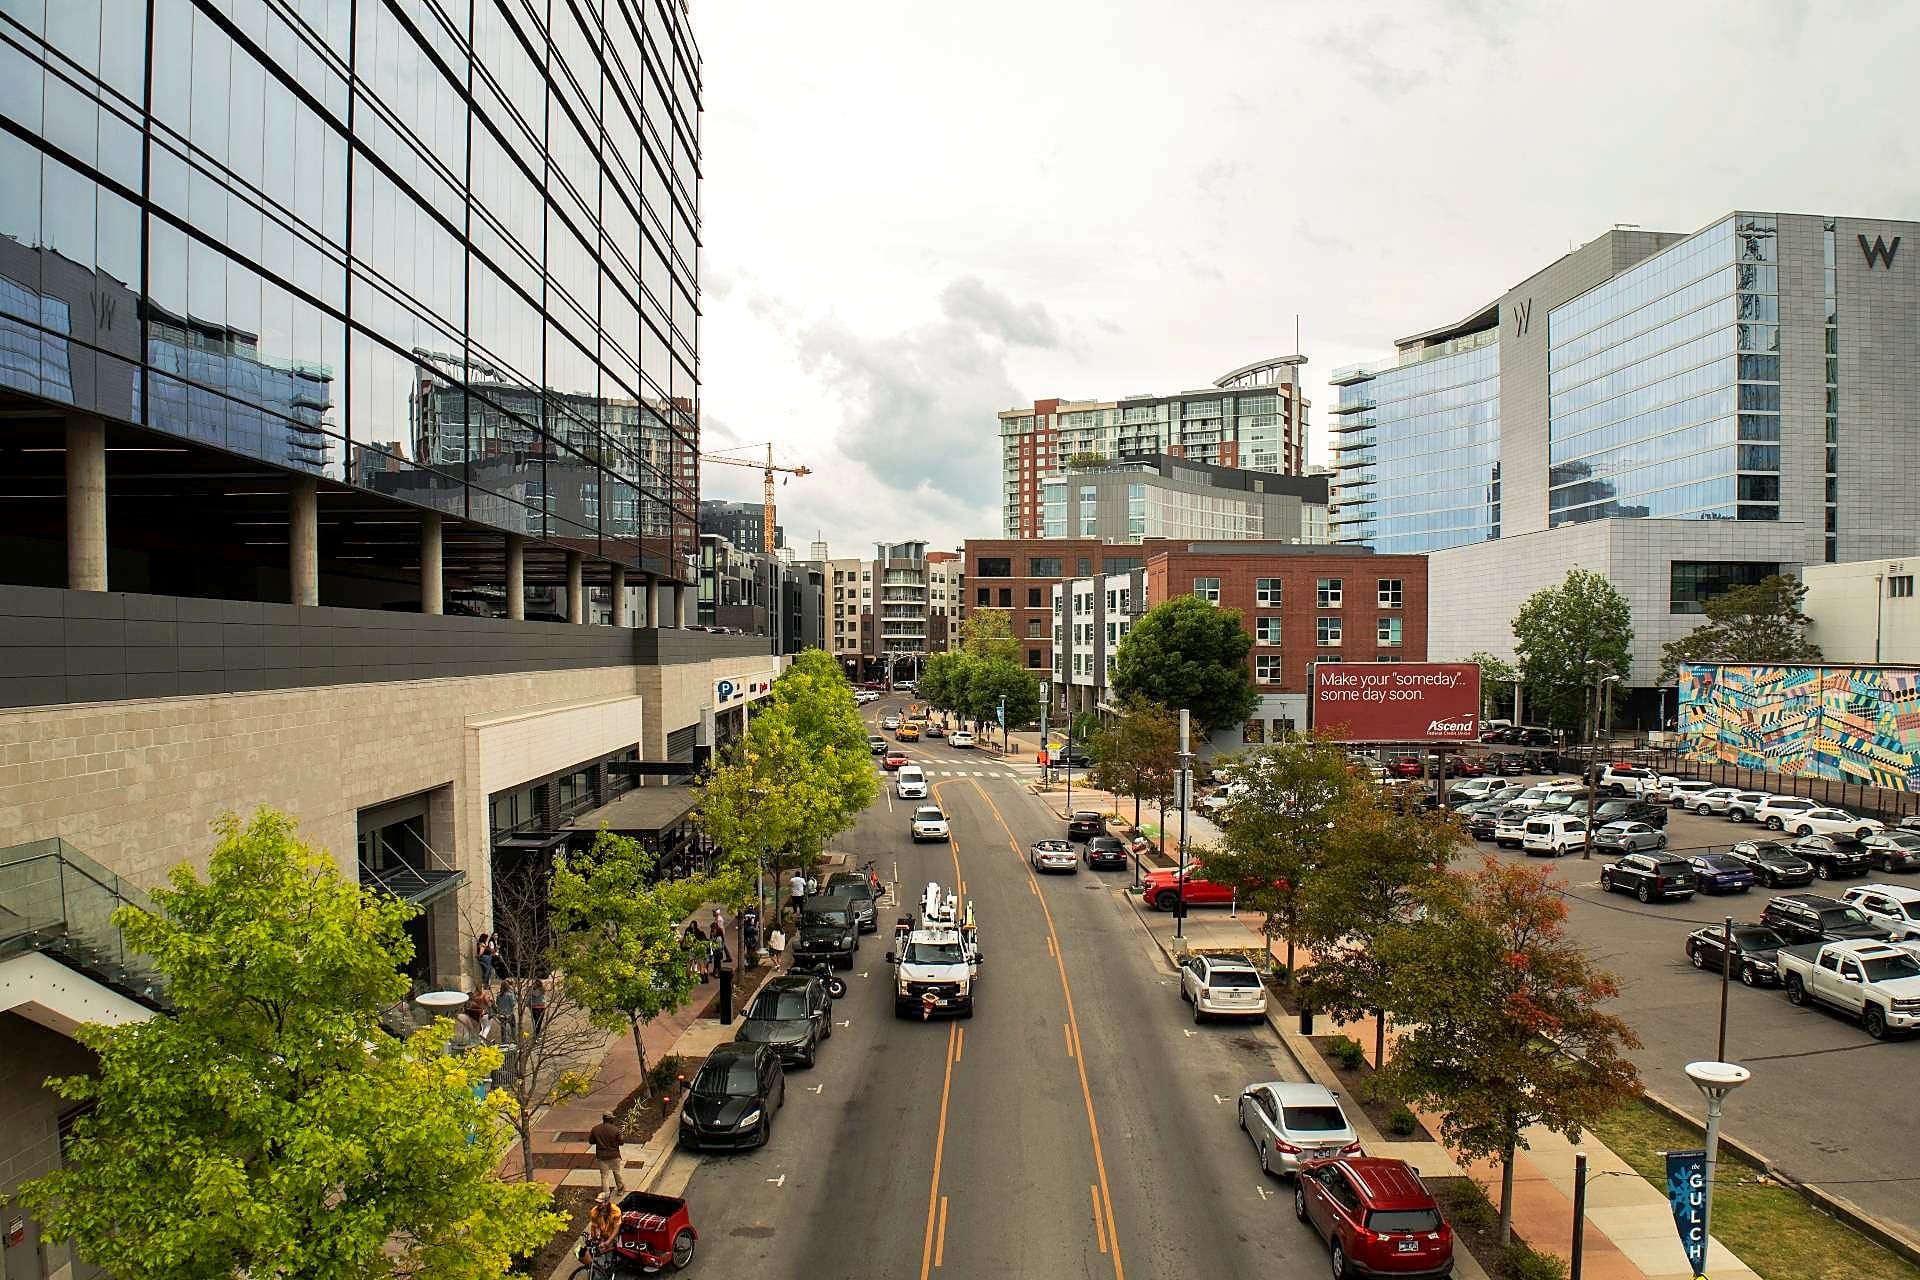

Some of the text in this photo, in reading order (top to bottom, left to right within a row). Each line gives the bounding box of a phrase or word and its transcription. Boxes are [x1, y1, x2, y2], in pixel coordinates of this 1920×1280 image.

[1857, 233, 1902, 270] W
[1513, 297, 1532, 338] W
[722, 683, 730, 694] P
[1321, 672, 1358, 686] Make
[1360, 675, 1390, 689] your
[1320, 687, 1425, 704] some day soon.
[1428, 720, 1473, 731] Ascend
[1689, 1173, 1703, 1259] GULCH
